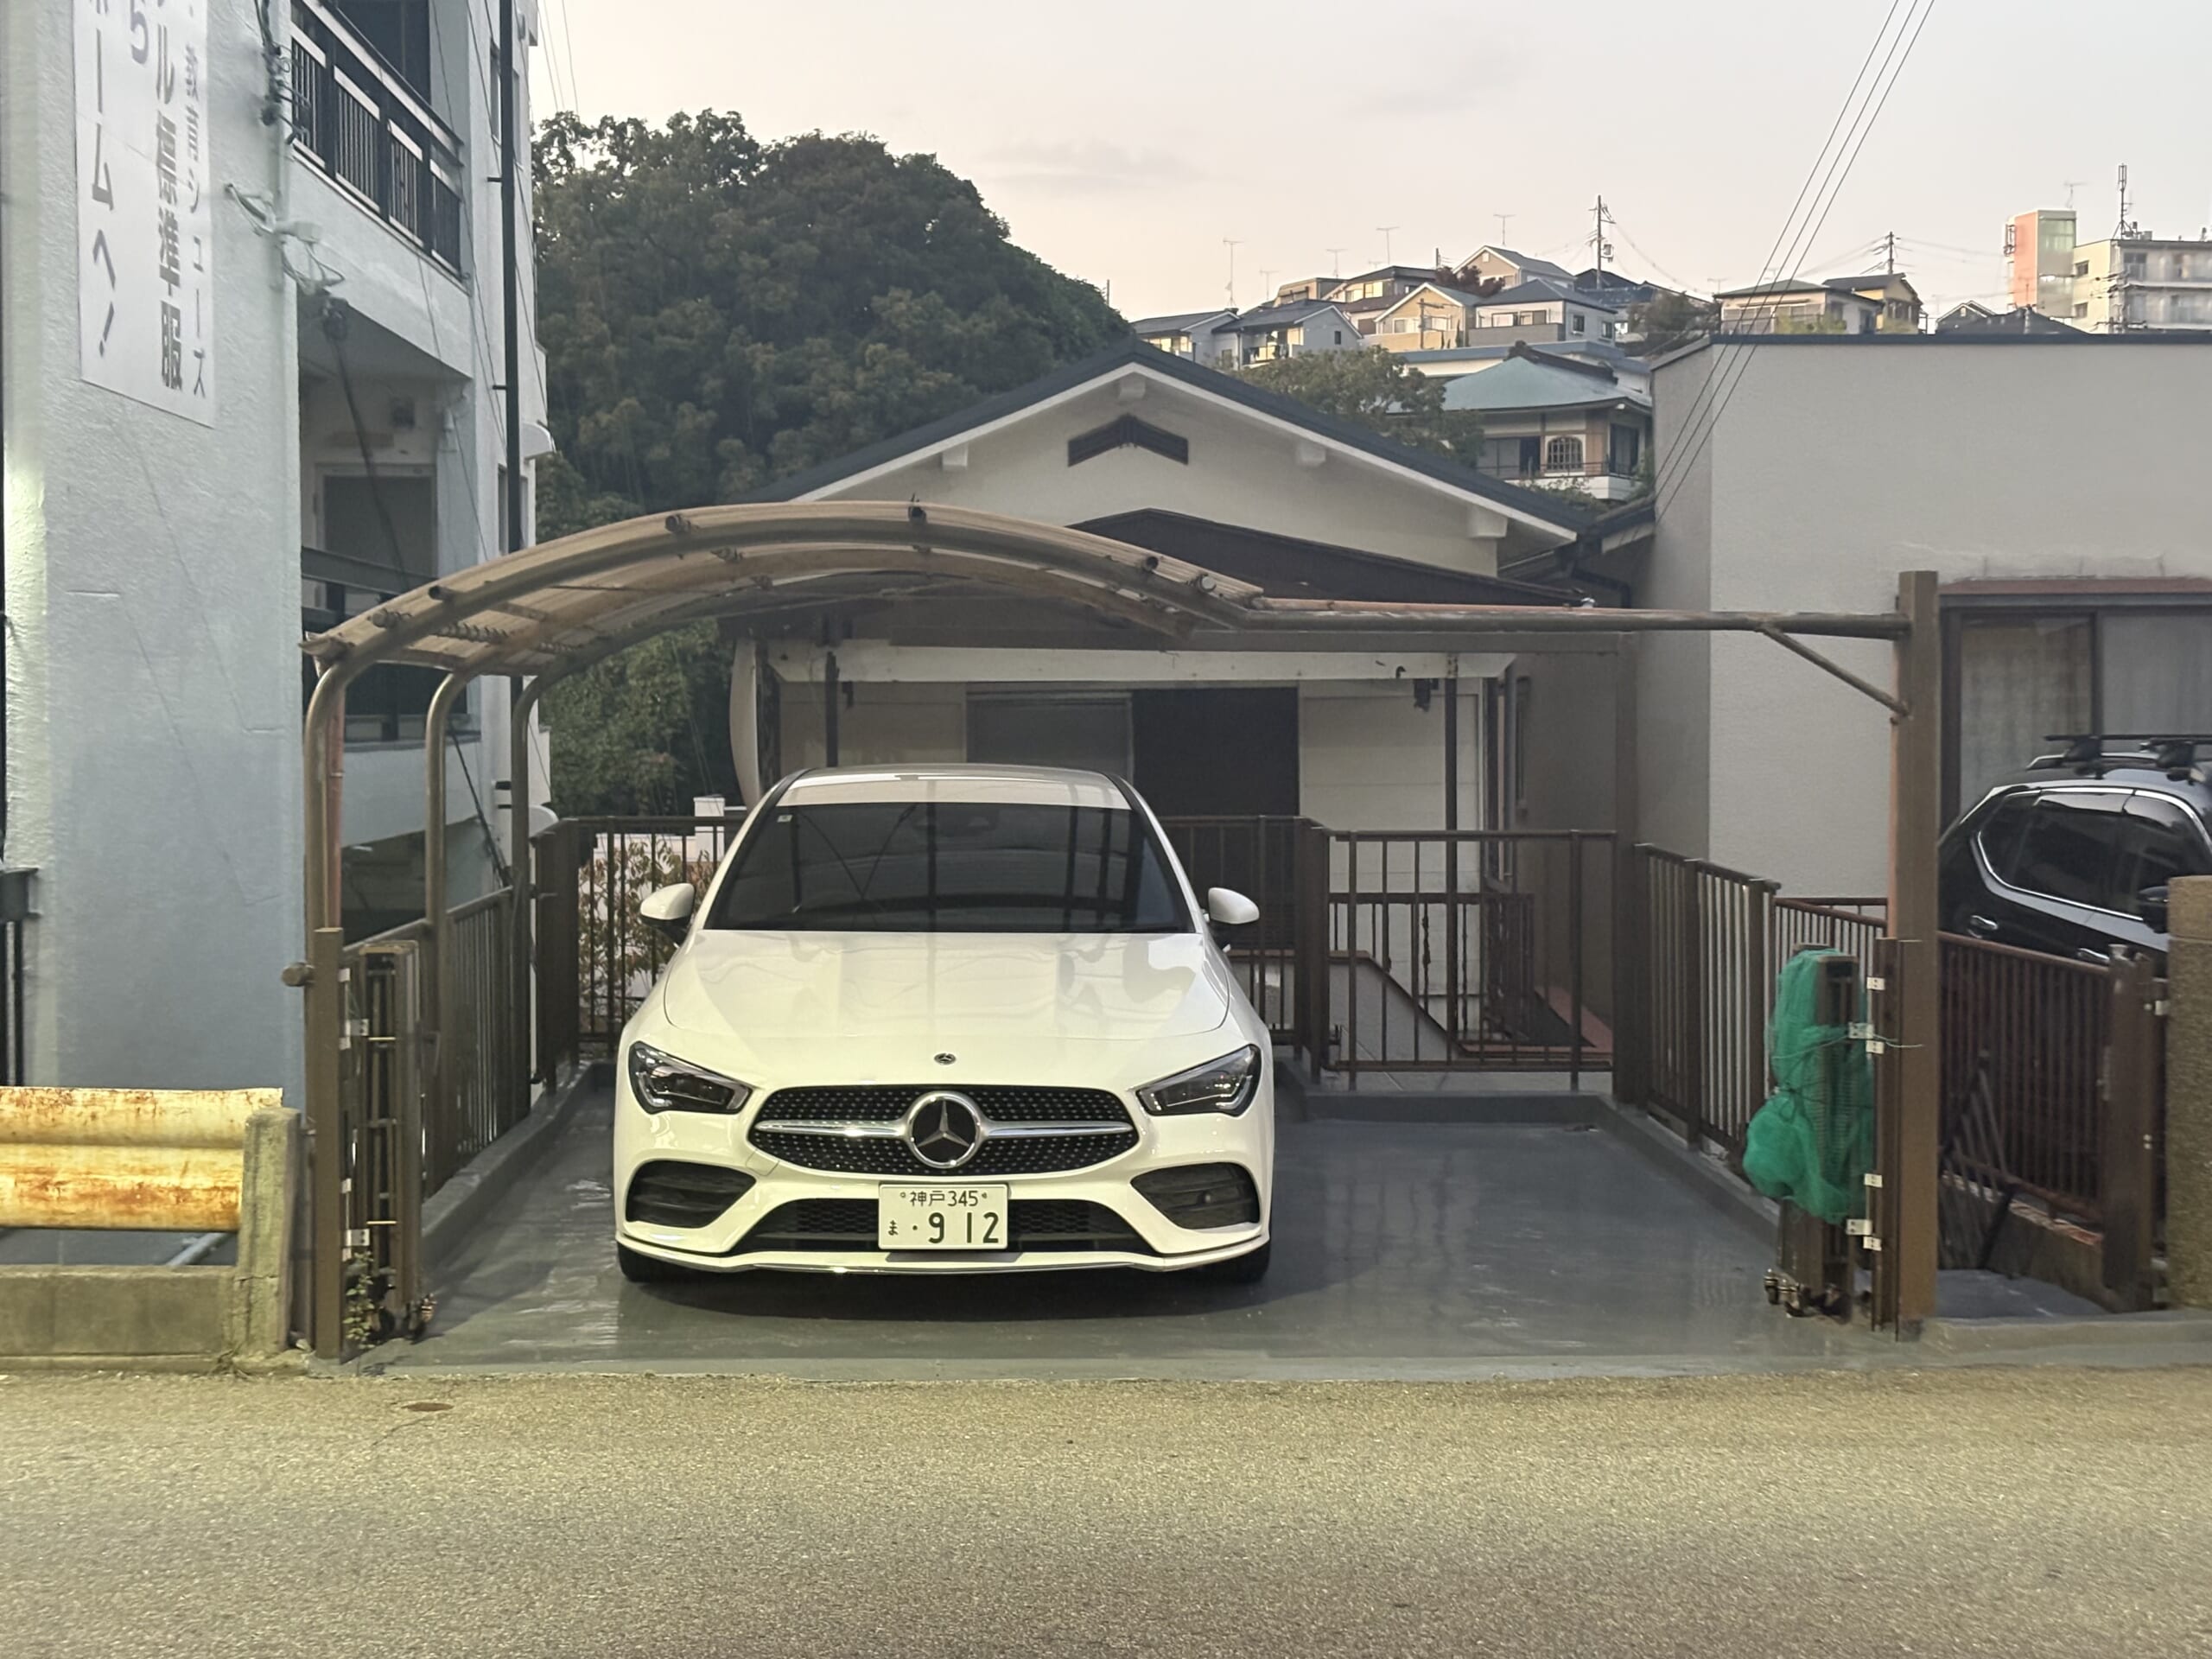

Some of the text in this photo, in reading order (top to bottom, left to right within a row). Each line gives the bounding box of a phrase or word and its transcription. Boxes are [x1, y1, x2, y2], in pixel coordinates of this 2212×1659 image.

[156, 0, 184, 391] ル標準服
[887, 1220, 899, 1236] ま
